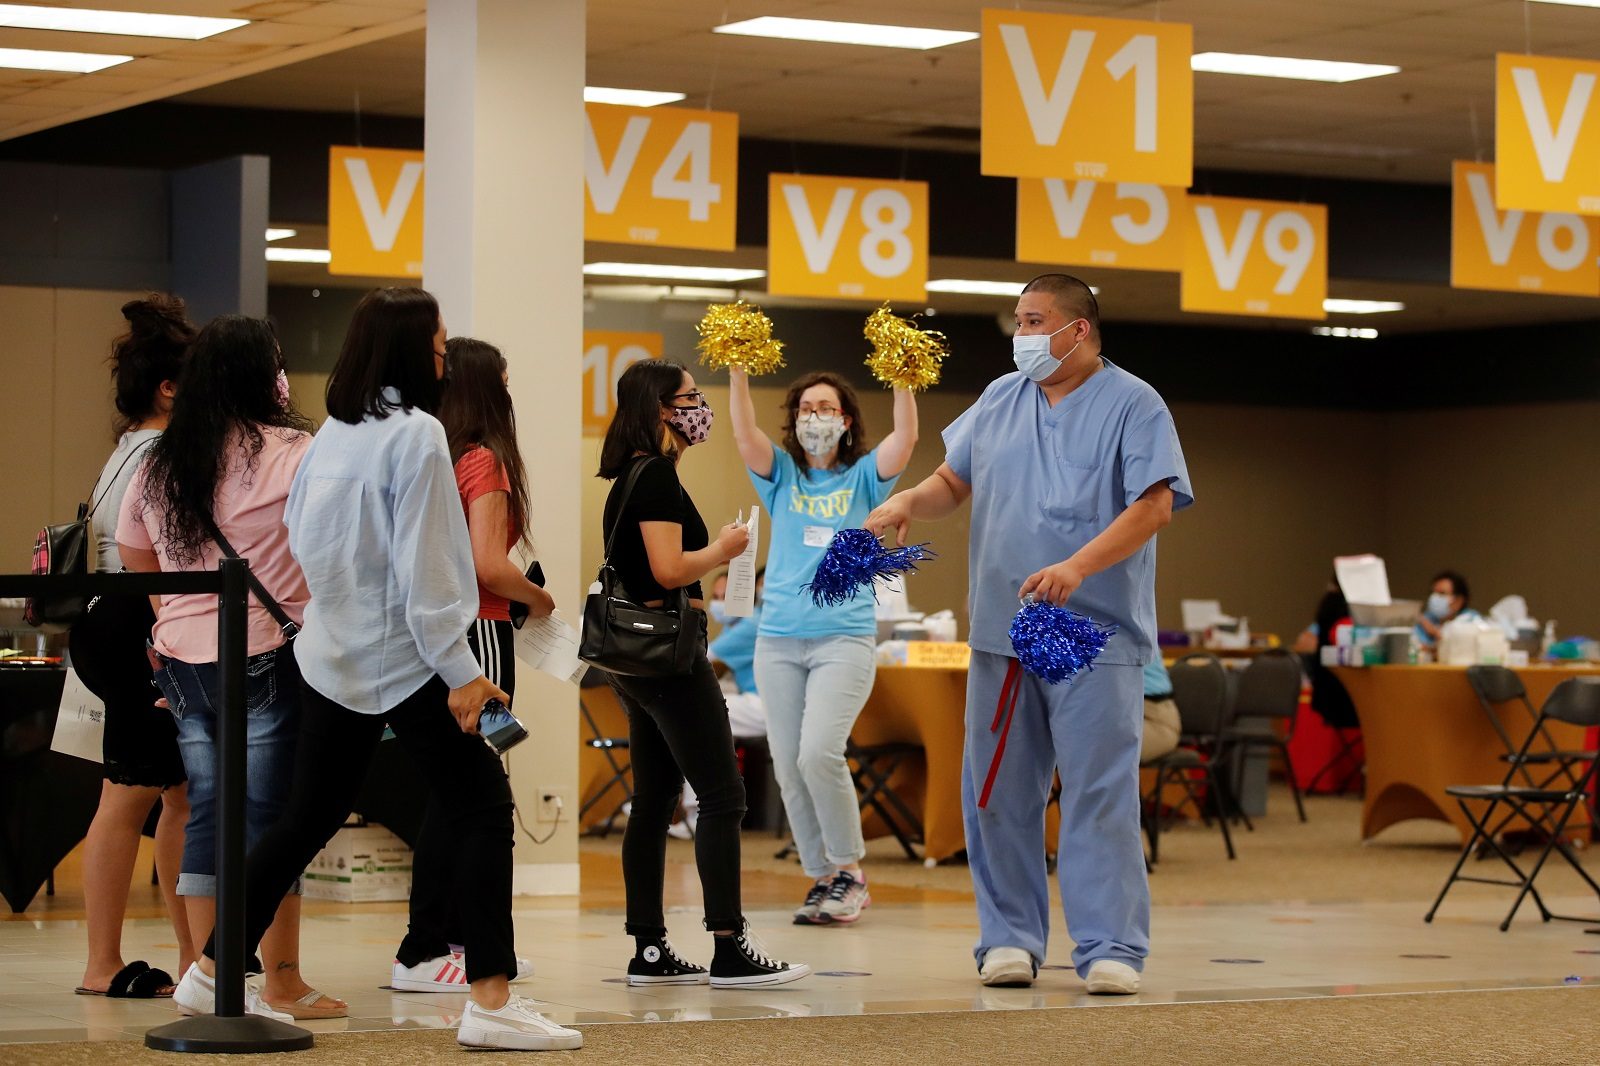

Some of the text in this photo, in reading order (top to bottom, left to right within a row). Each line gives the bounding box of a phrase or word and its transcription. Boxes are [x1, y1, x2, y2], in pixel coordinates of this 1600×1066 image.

[998, 23, 1158, 153] V1
[1511, 67, 1597, 183] V
[343, 157, 424, 252] V
[584, 110, 721, 222] V4
[1043, 177, 1170, 244] V5
[781, 184, 914, 278] V8
[1195, 205, 1316, 295] V9
